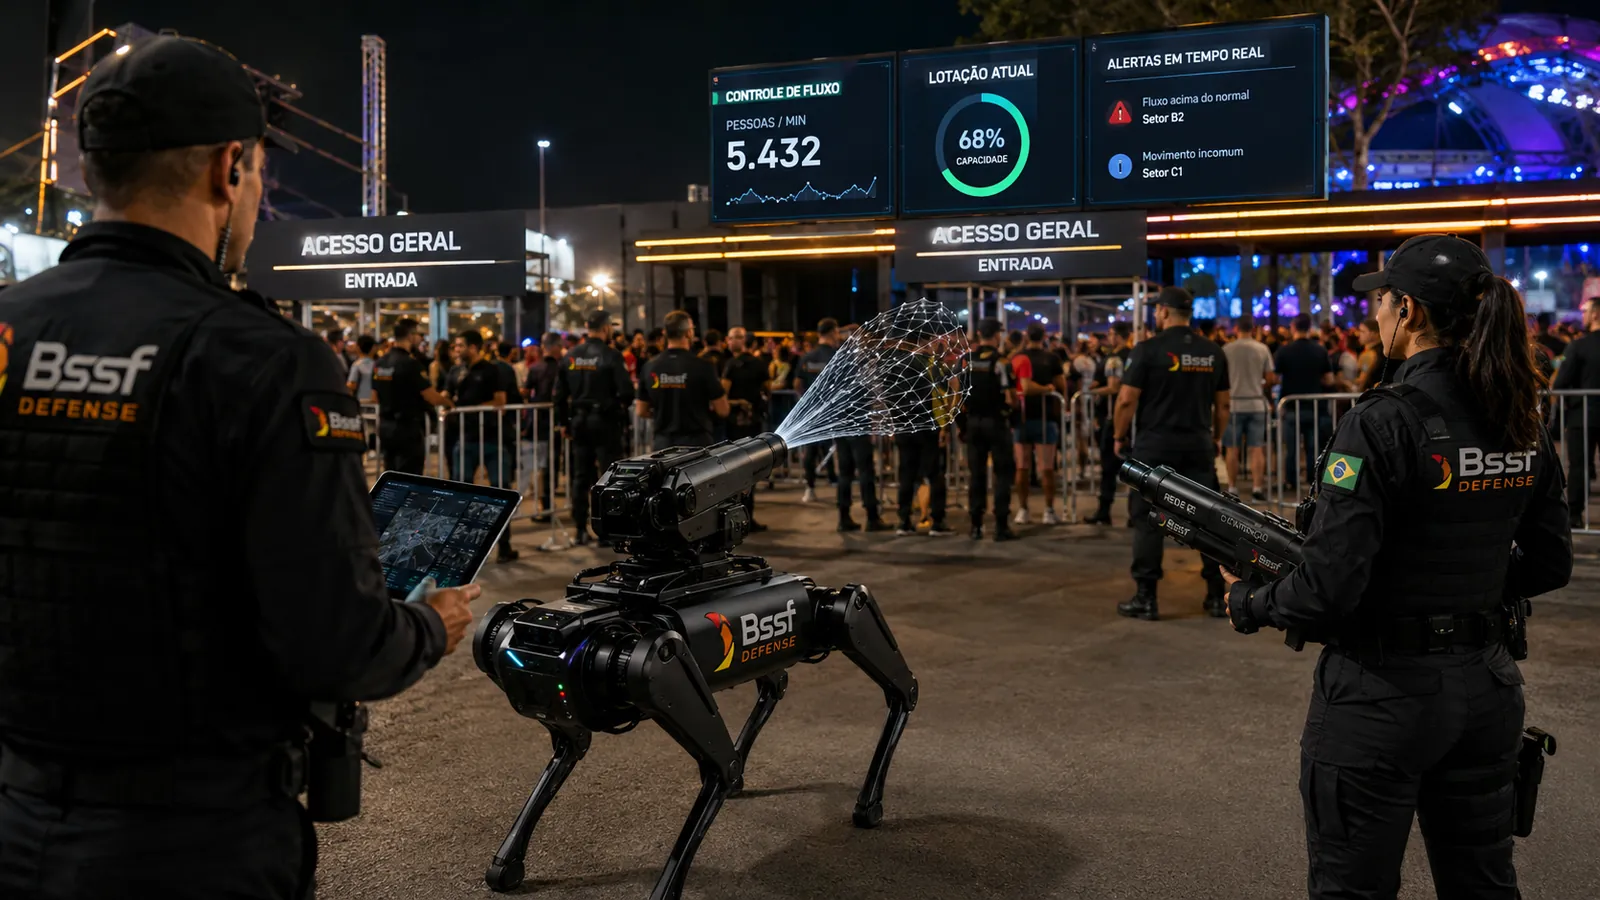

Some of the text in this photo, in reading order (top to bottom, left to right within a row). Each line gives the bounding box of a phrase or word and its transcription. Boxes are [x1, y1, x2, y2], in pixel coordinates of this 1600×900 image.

[1107, 46, 1265, 71] ALERTAS EM TEMPO REAL
[928, 63, 1035, 85] LOTAÇÃO ATUAL
[725, 81, 840, 103] CONTROLE DE FLUXO
[1142, 89, 1250, 108] Fluxo acima do normal
[726, 114, 807, 132] PESSOAS / MIN
[1142, 111, 1185, 125] Setor B2
[958, 127, 1005, 150] 68%
[726, 135, 821, 171] 5.432
[956, 154, 1008, 166] CAPACIDADE
[1142, 147, 1244, 162] Movimento incomum
[1142, 166, 1183, 179] Setor C1
[931, 219, 1100, 245] ACESSO GERAL
[300, 230, 462, 257] ACESSO GERAL
[978, 256, 1054, 273] ENTRADA
[344, 271, 418, 289] ENTRADA
[23, 341, 159, 396] Bssf
[18, 397, 139, 422] DEFENSE
[1458, 475, 1535, 492] DEFENSE
[740, 599, 797, 647] Bssf
[741, 635, 797, 663] DEFENSE
